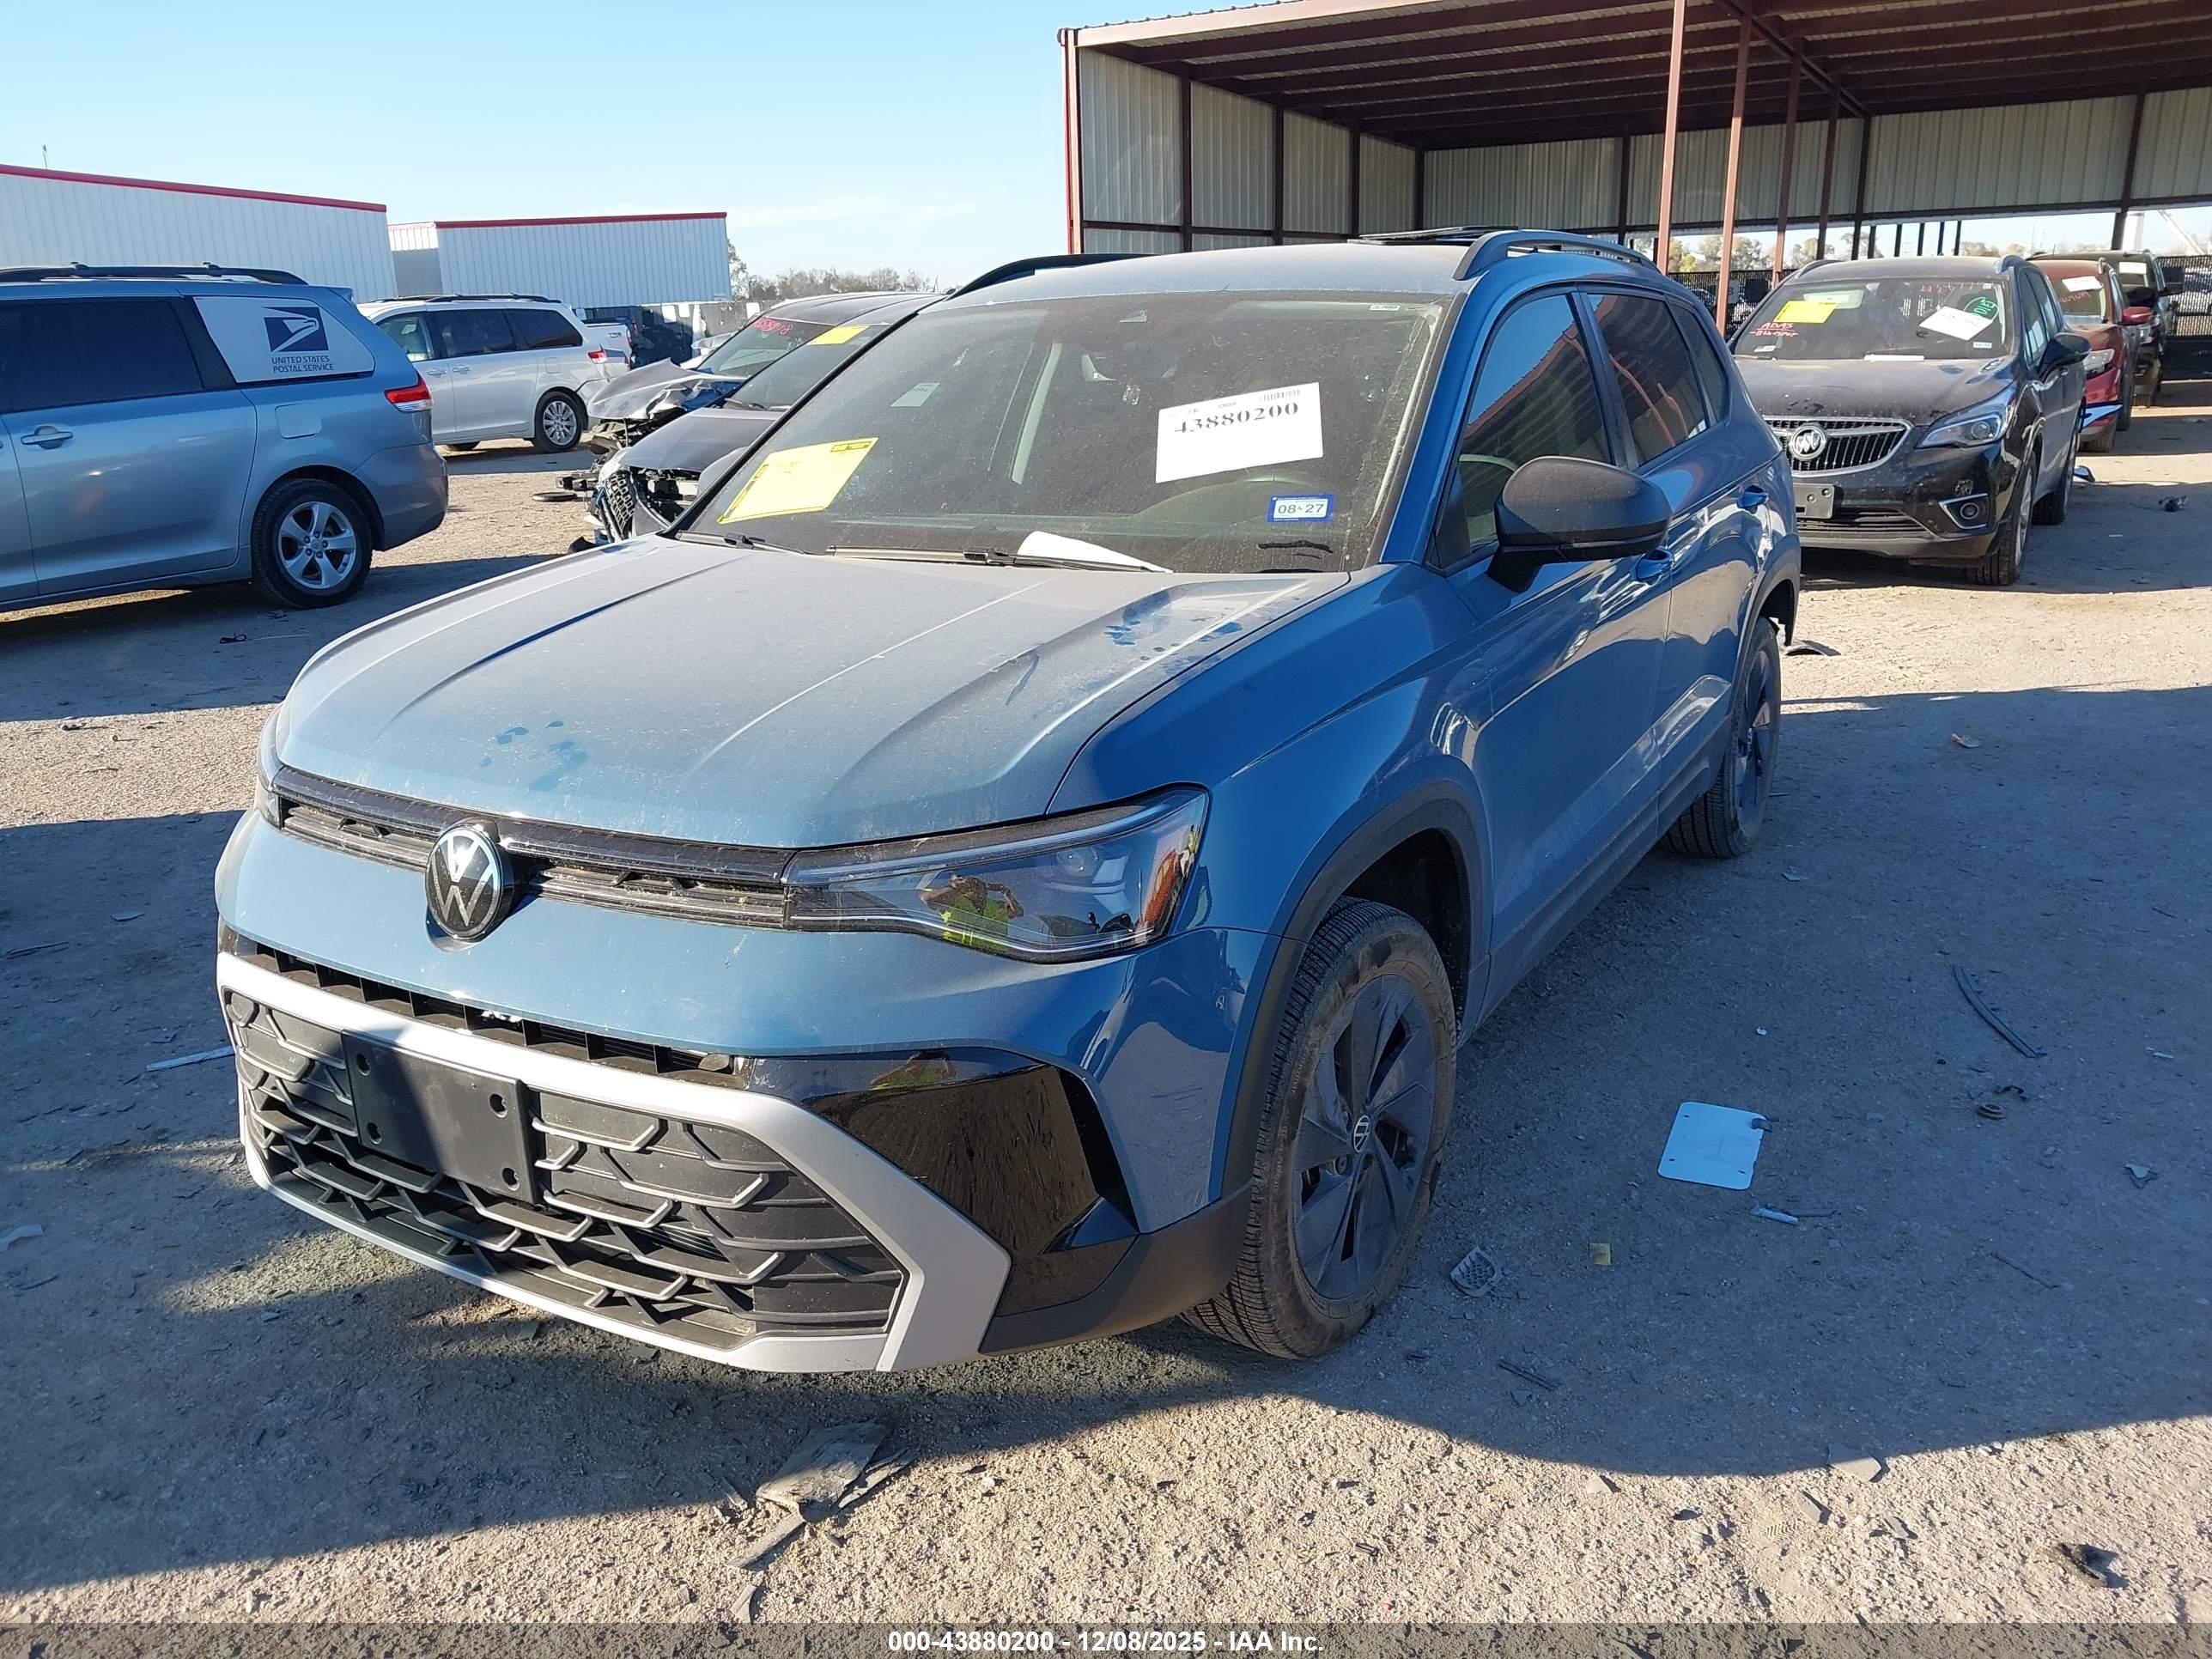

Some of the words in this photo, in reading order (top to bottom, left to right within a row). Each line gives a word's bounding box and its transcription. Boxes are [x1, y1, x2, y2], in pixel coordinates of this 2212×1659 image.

[303, 363, 335, 372] SERVICE
[1174, 402, 1298, 433] 43880200
[1304, 503, 1325, 514] 27
[428, 827, 500, 935] VW
